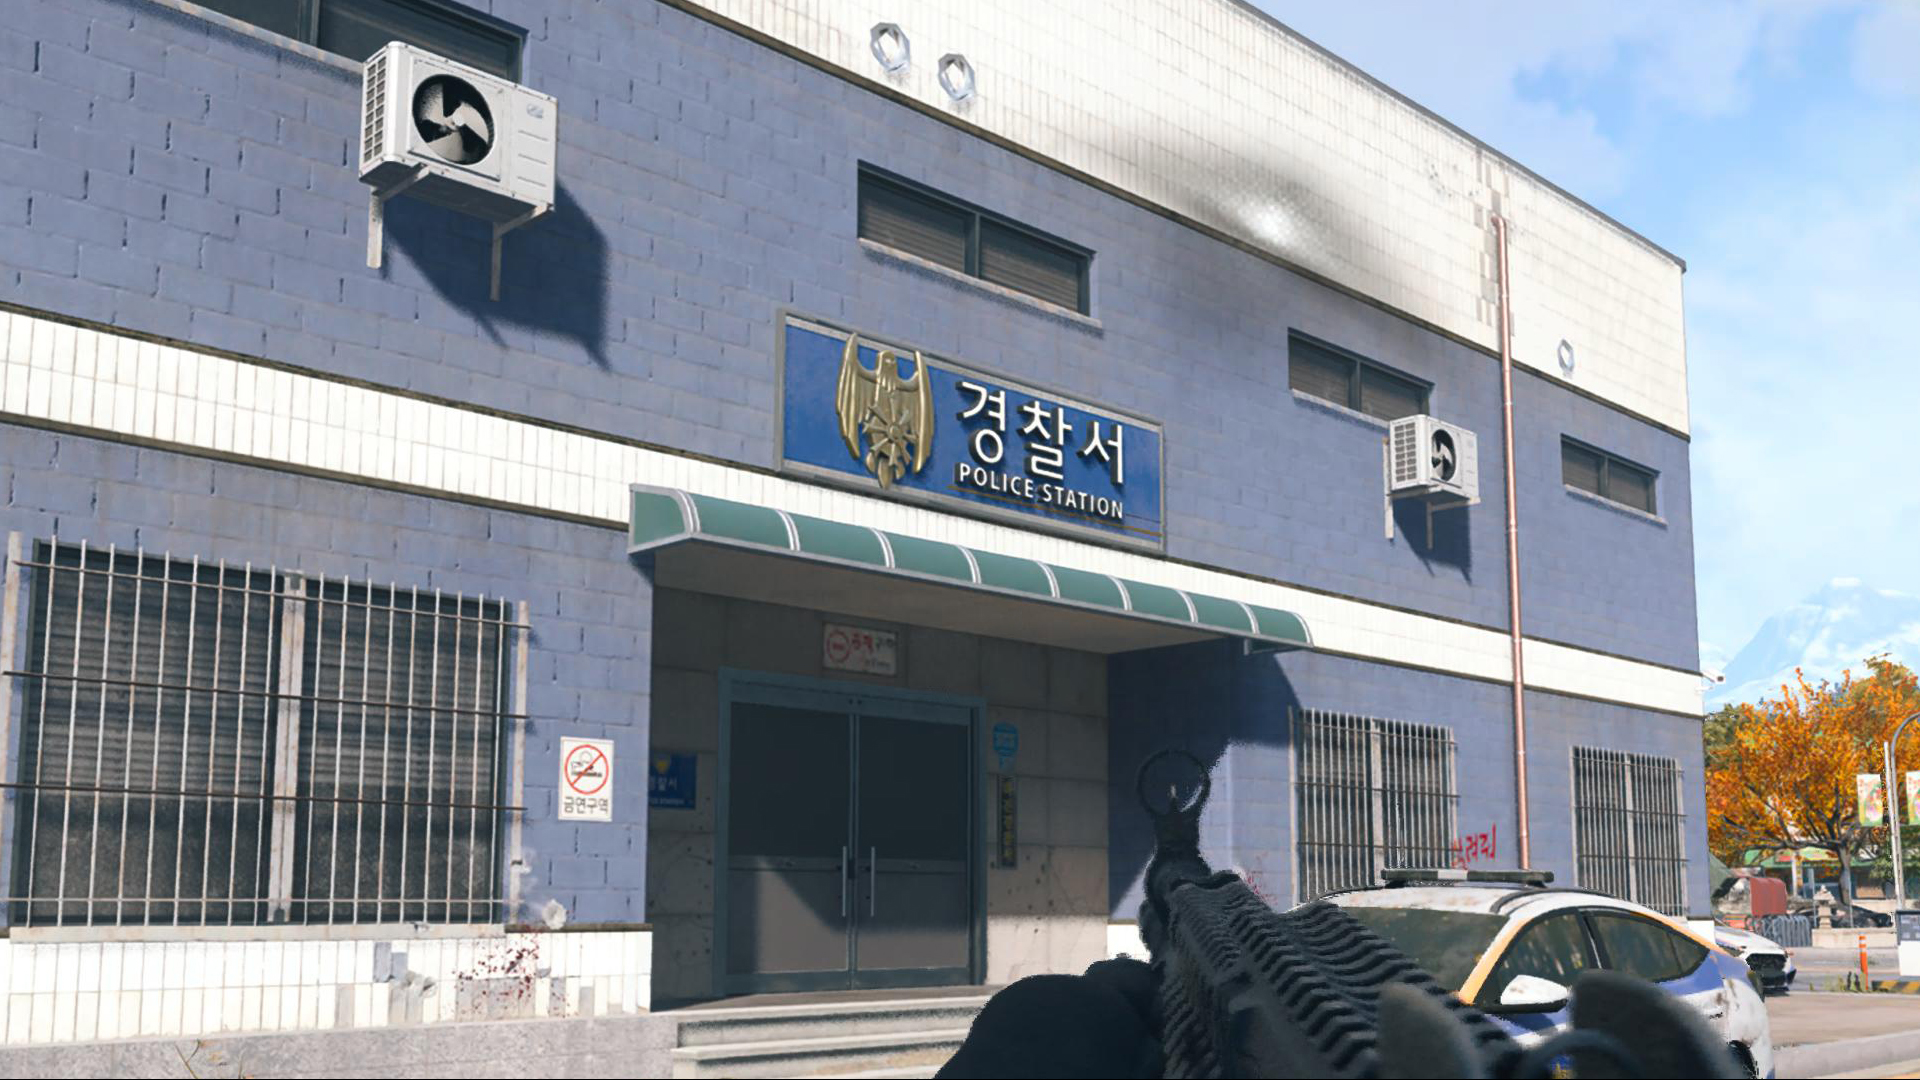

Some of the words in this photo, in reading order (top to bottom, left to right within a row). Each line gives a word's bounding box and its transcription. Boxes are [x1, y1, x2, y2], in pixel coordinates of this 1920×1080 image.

[957, 381, 1123, 485] 경찰서
[957, 463, 1034, 499] POLICE
[1042, 485, 1123, 520] STATION
[564, 795, 609, 814] 금연구역
